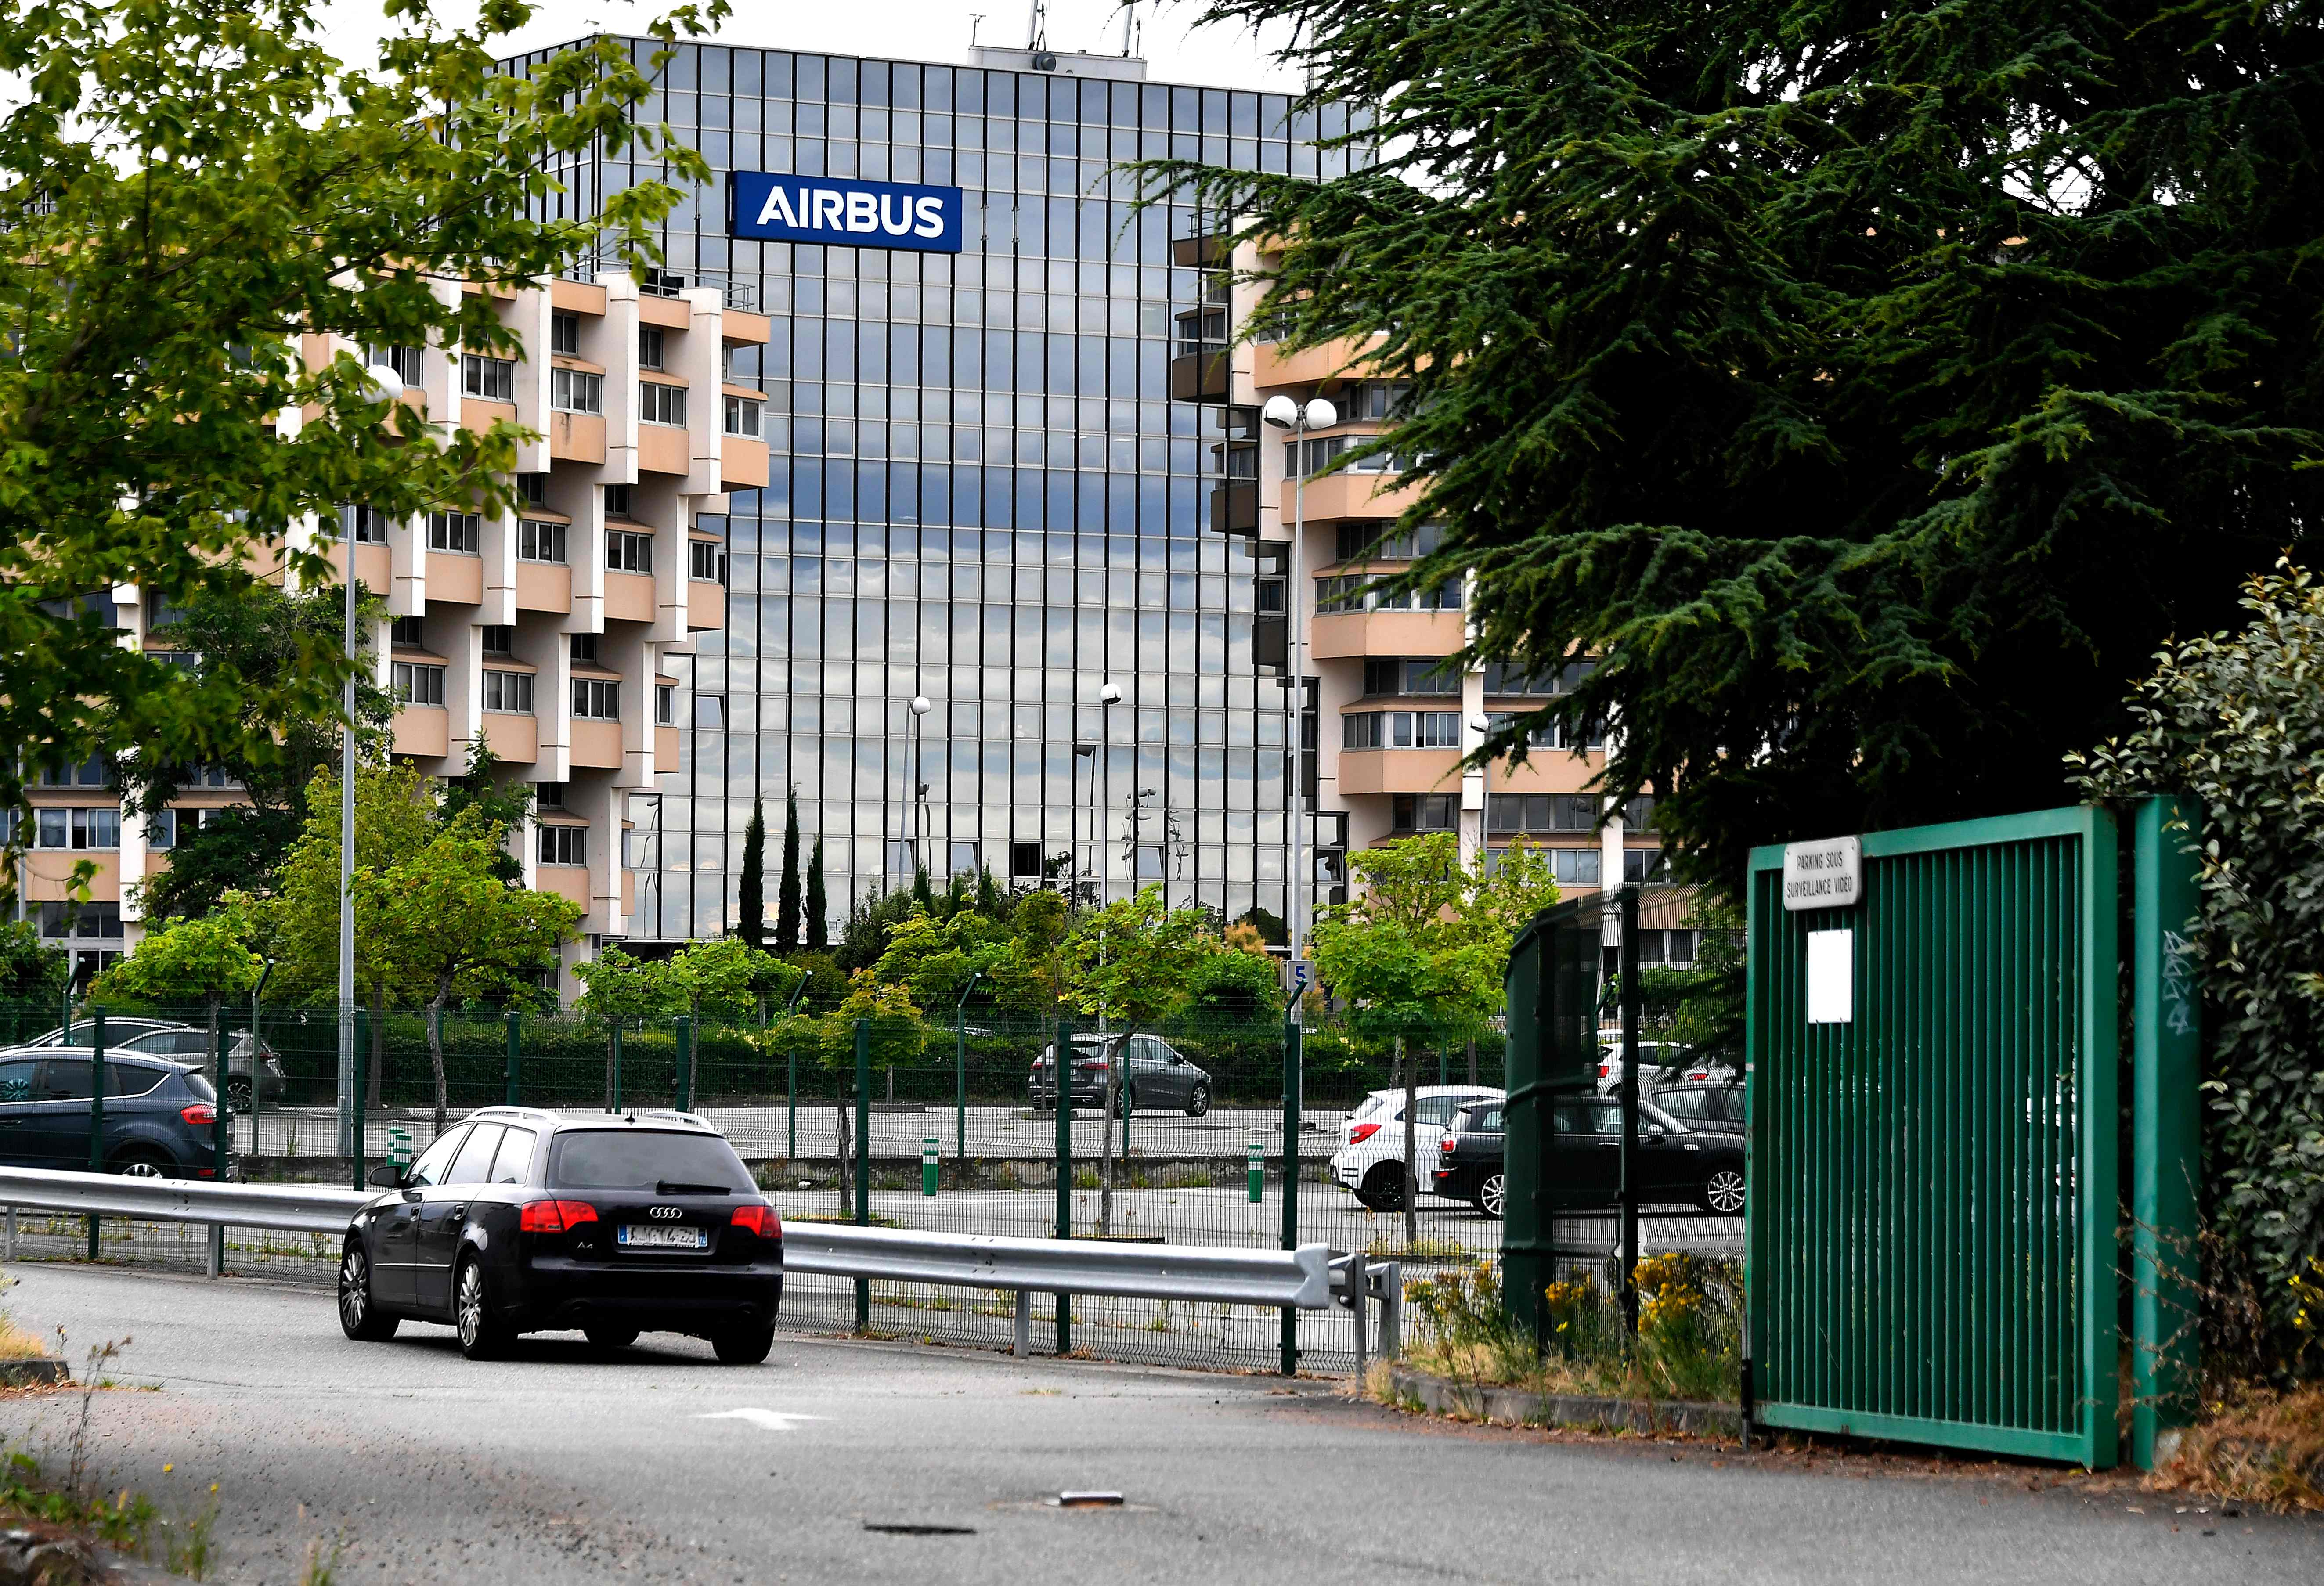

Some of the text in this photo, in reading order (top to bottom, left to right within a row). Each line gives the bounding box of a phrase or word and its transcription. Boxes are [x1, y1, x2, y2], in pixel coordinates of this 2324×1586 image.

[756, 186, 944, 238] AIRBUS
[1797, 851, 1843, 870] PARKING SOUS
[1786, 879, 1831, 898] SURVEILLANCE
[1295, 966, 1306, 986] 5
